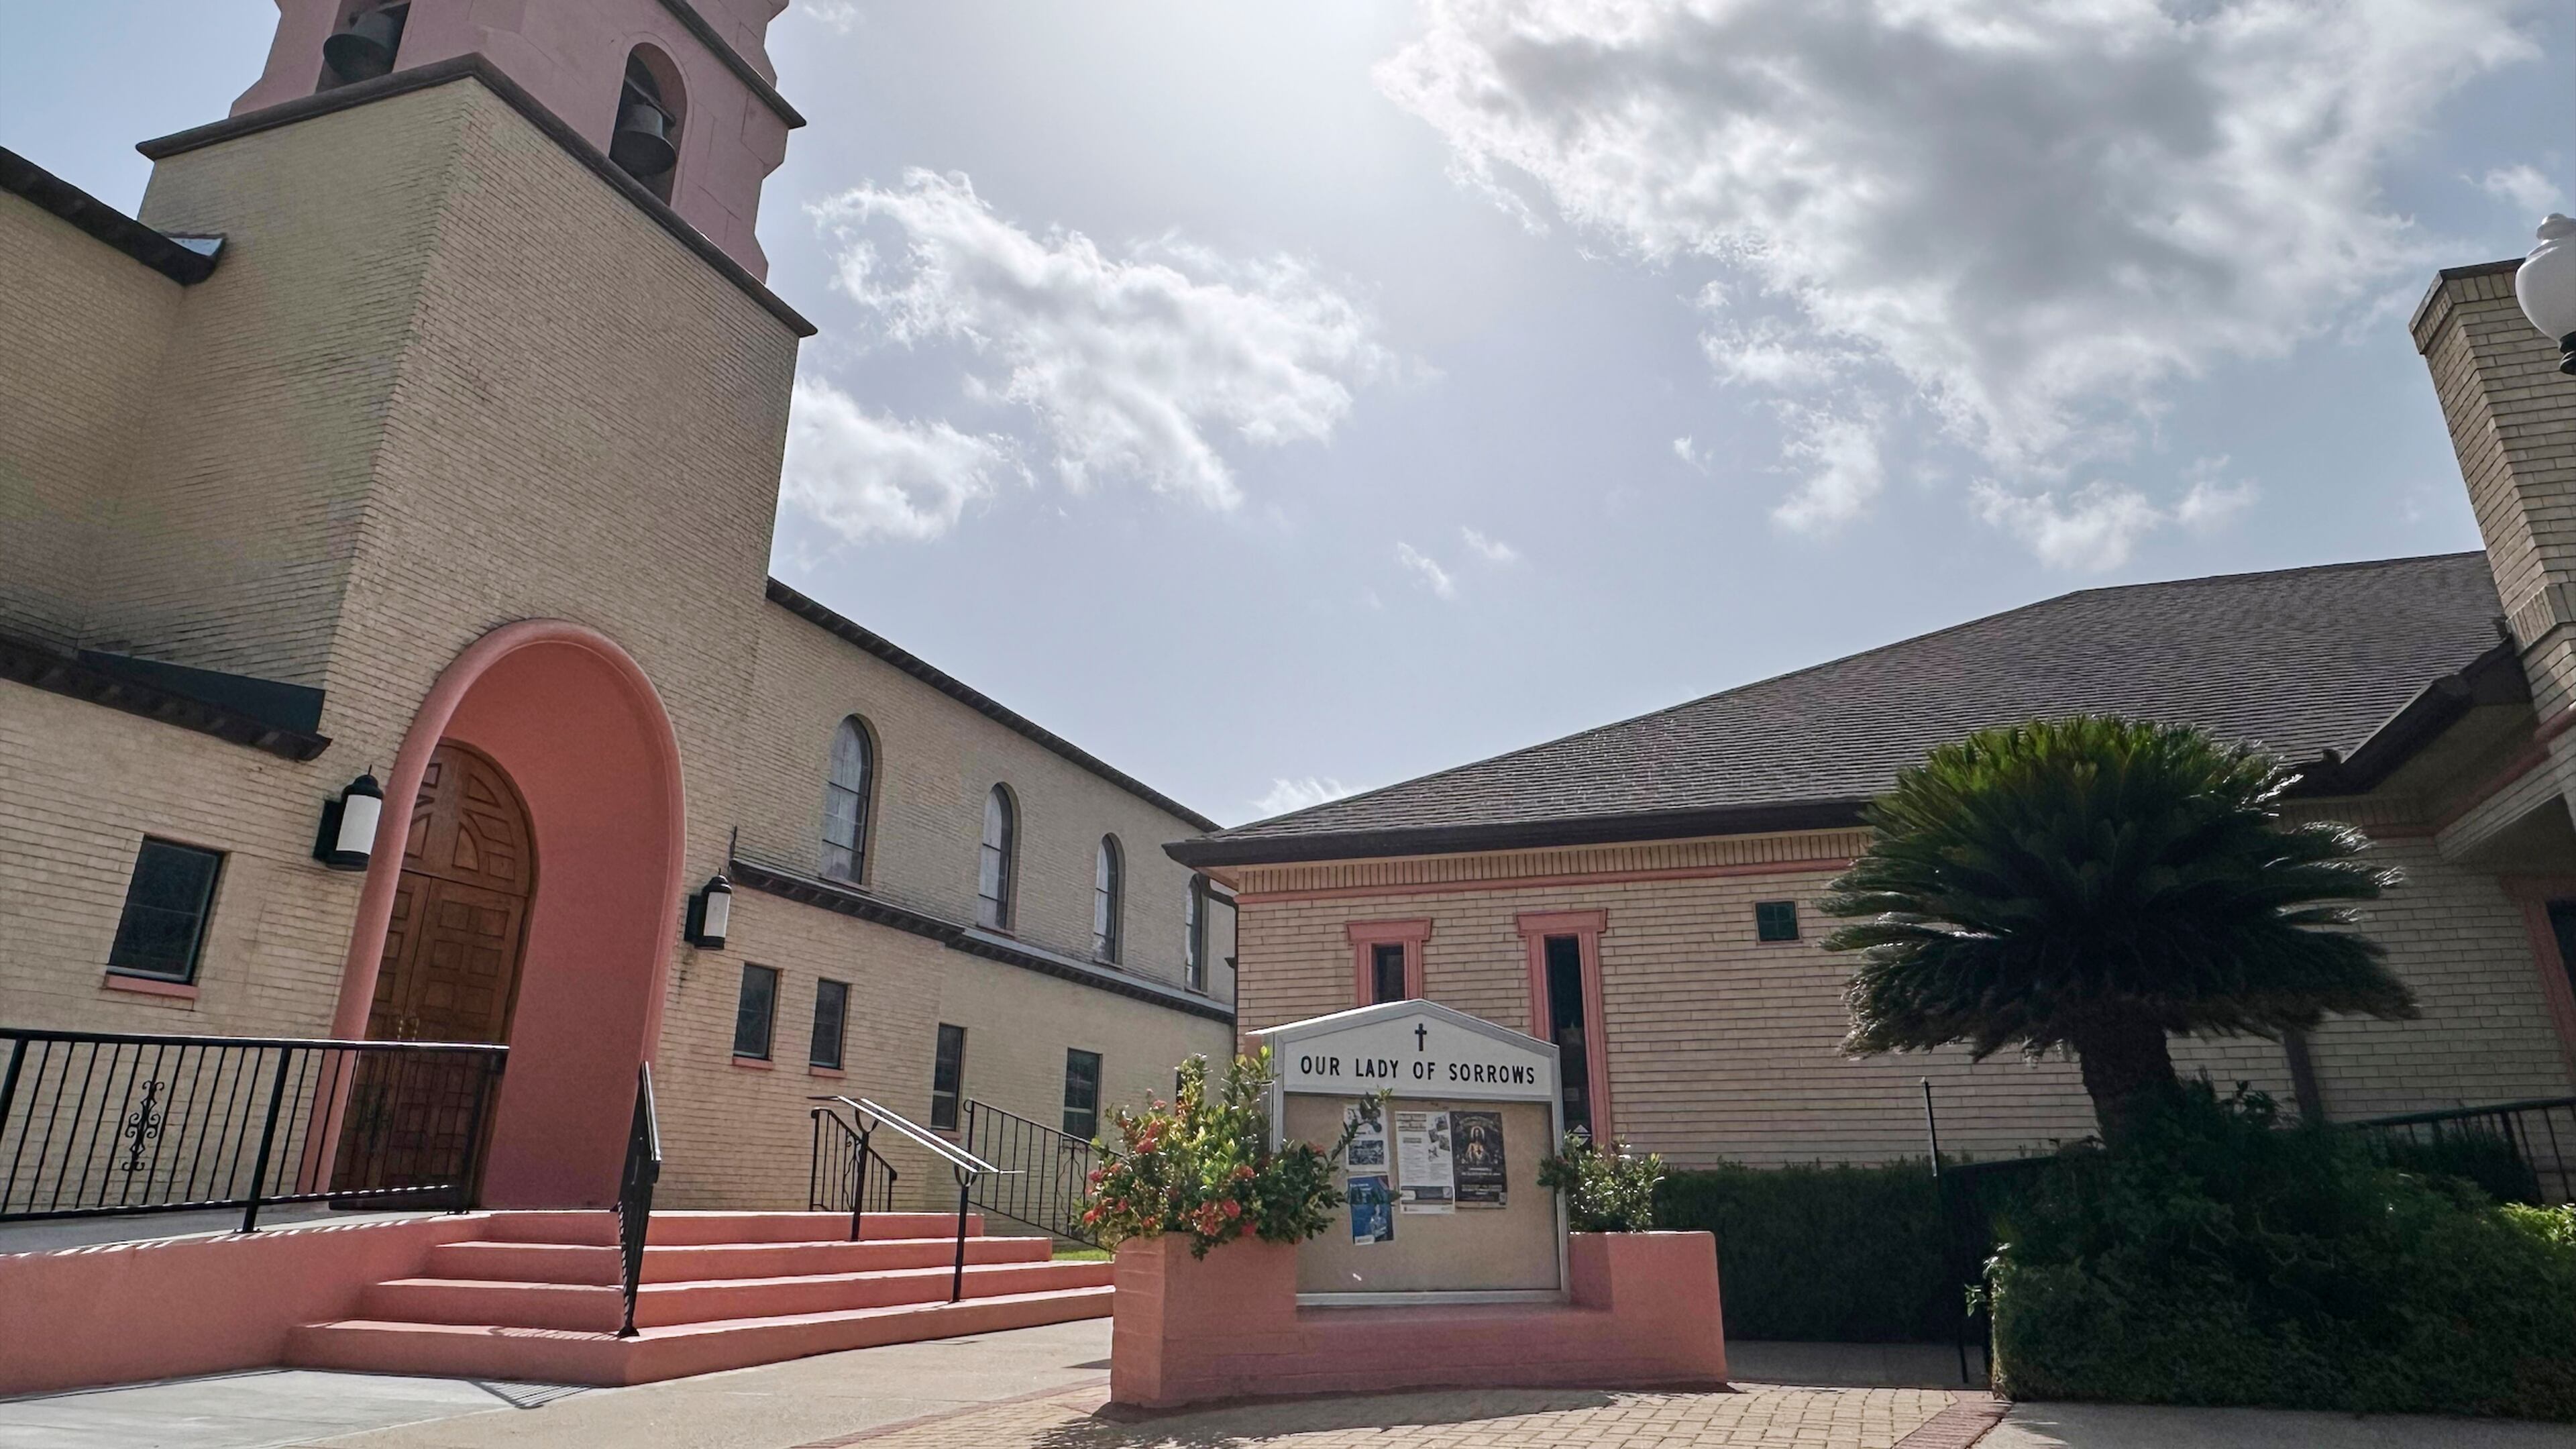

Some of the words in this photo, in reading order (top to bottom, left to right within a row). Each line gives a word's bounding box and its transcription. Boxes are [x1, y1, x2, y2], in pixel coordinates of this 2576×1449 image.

[1300, 1055, 1340, 1076] OUR
[1355, 1058, 1399, 1079] LADY
[1413, 1061, 1436, 1081] OF
[1448, 1063, 1535, 1085] SORROWS
